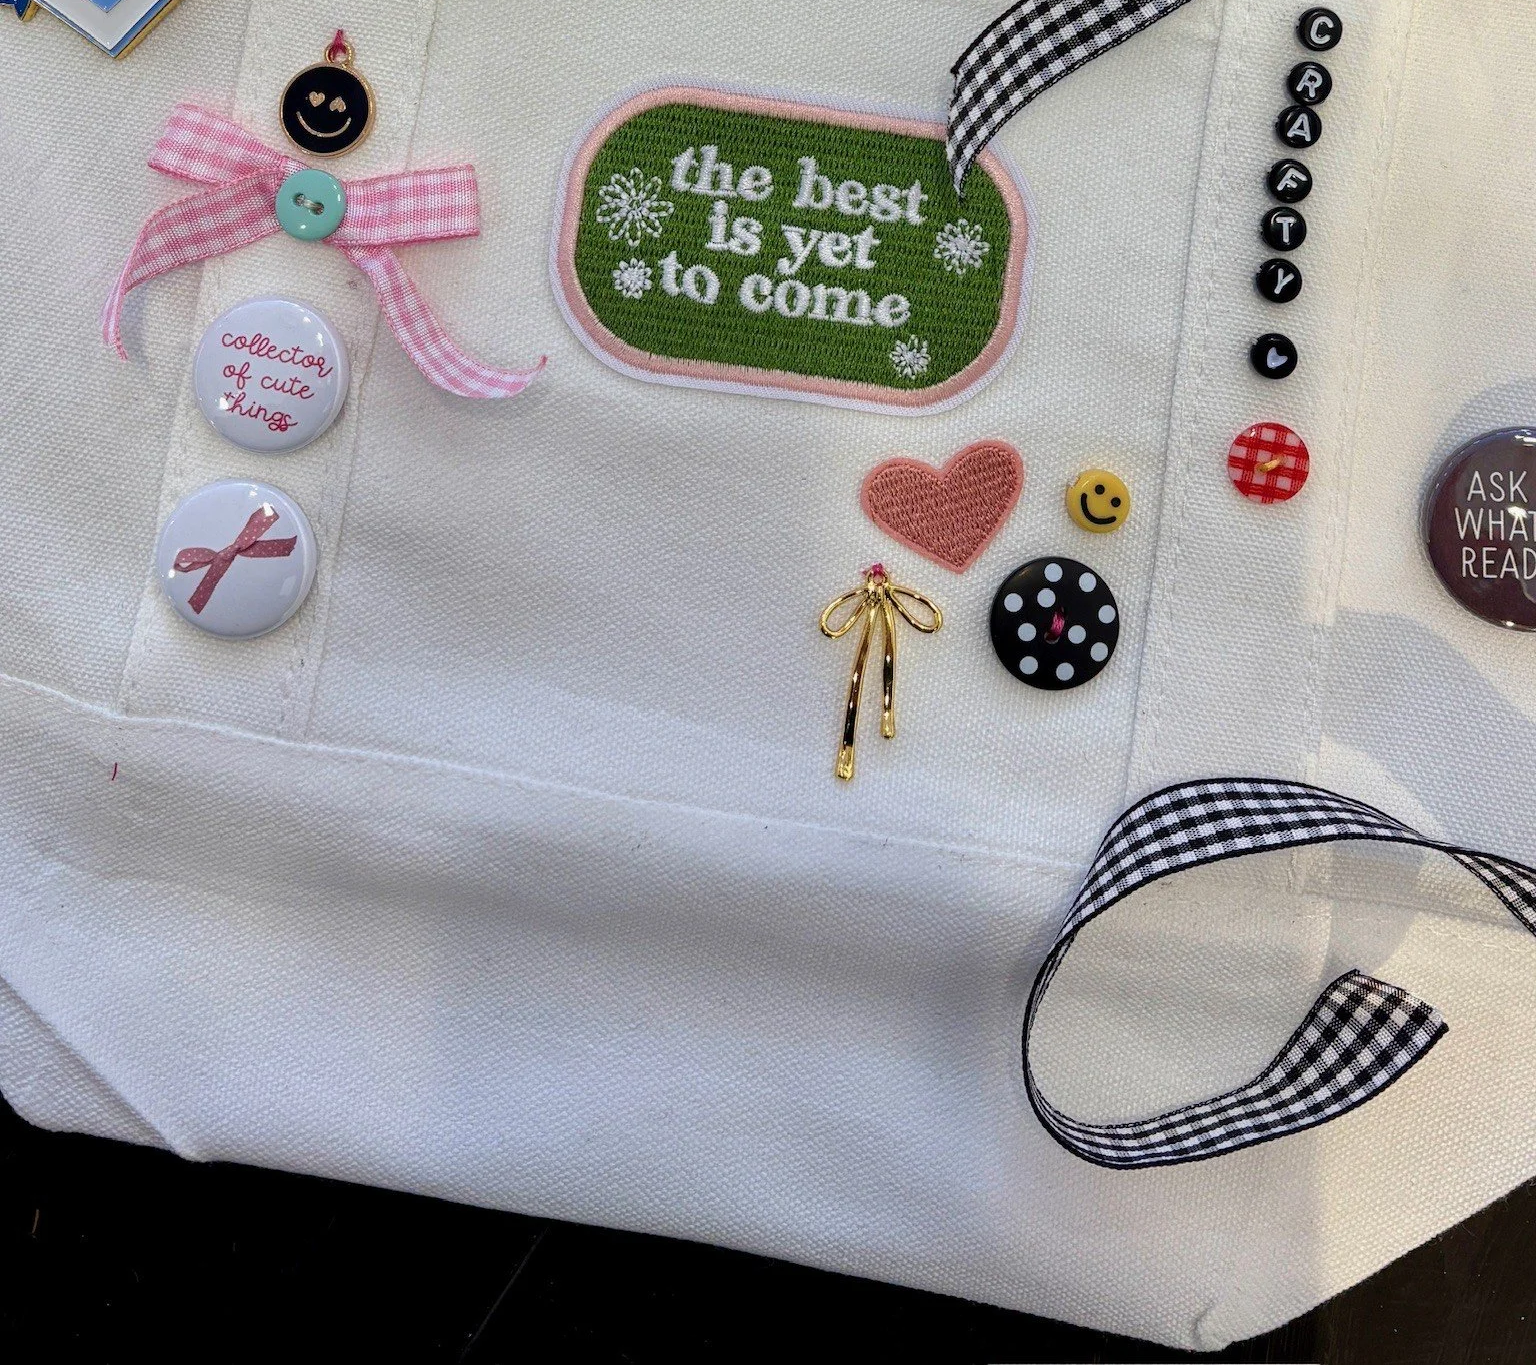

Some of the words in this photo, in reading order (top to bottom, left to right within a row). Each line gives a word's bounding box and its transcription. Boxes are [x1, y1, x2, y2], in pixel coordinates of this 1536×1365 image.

[1273, 15, 1335, 295] CRAFTY
[671, 145, 774, 201] the
[792, 156, 928, 225] best
[706, 200, 764, 256] is
[777, 225, 880, 275] yet
[658, 250, 720, 305] to
[739, 273, 911, 329] come
[222, 333, 333, 377] collector
[223, 362, 252, 390] of
[261, 376, 315, 399] cute
[223, 392, 298, 432] things
[1467, 471, 1528, 503] ASK
